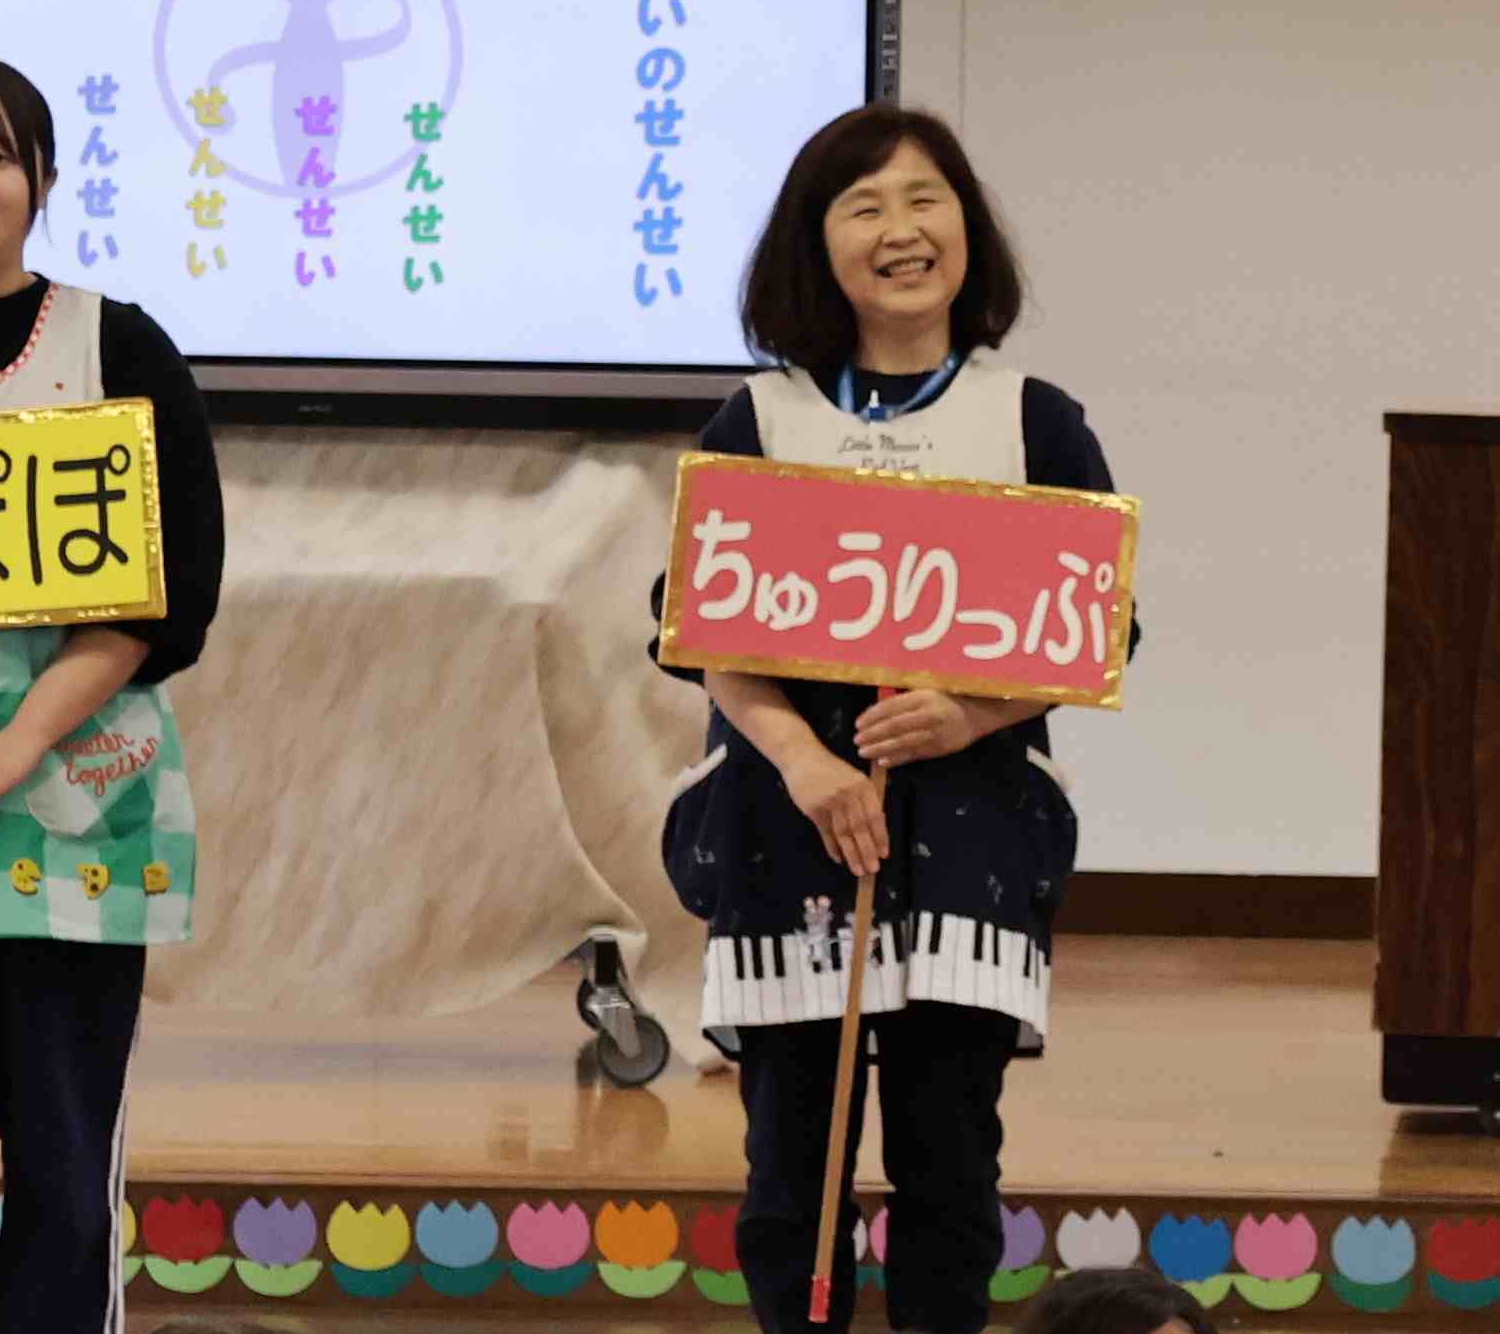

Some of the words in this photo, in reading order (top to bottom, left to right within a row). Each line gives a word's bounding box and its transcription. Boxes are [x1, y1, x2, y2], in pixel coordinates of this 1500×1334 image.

[75, 73, 122, 269] せんせい
[186, 86, 230, 279] せんせい
[293, 94, 338, 287] せんせい
[402, 101, 446, 293] せんせい
[691, 508, 1115, 667] ちゅうりっぷ
